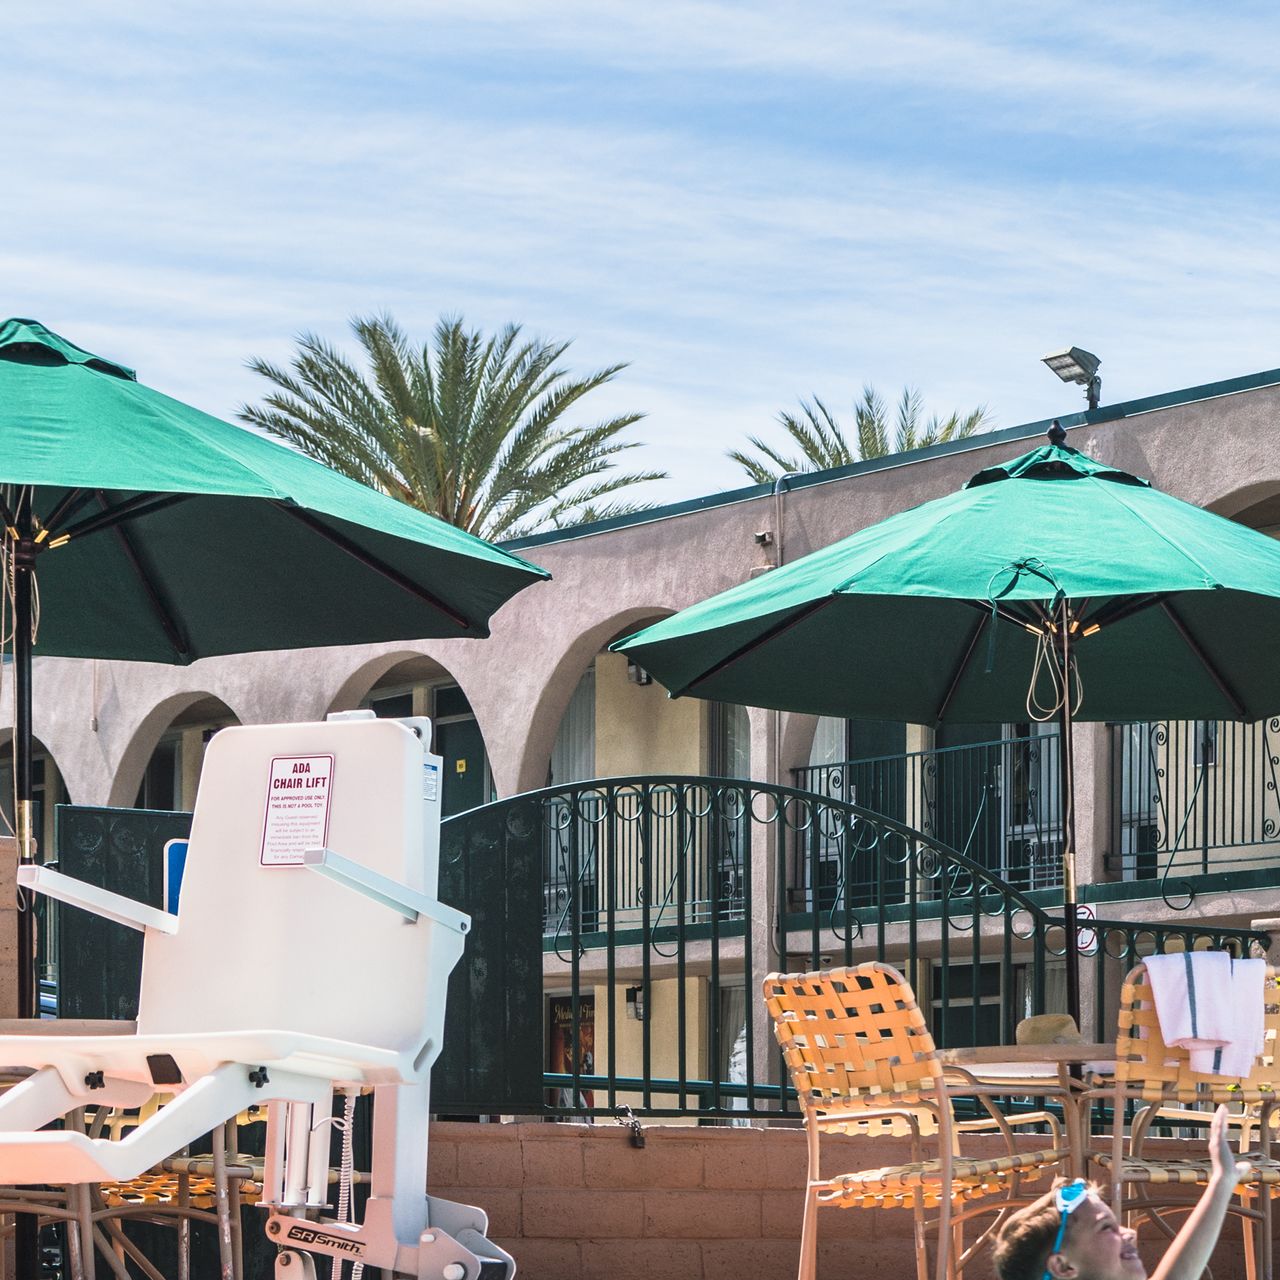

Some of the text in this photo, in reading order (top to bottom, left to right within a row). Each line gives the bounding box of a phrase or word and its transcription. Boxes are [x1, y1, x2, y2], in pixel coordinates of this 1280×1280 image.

[292, 763, 311, 774] ADA
[273, 777, 327, 789] CHAIR LIFT
